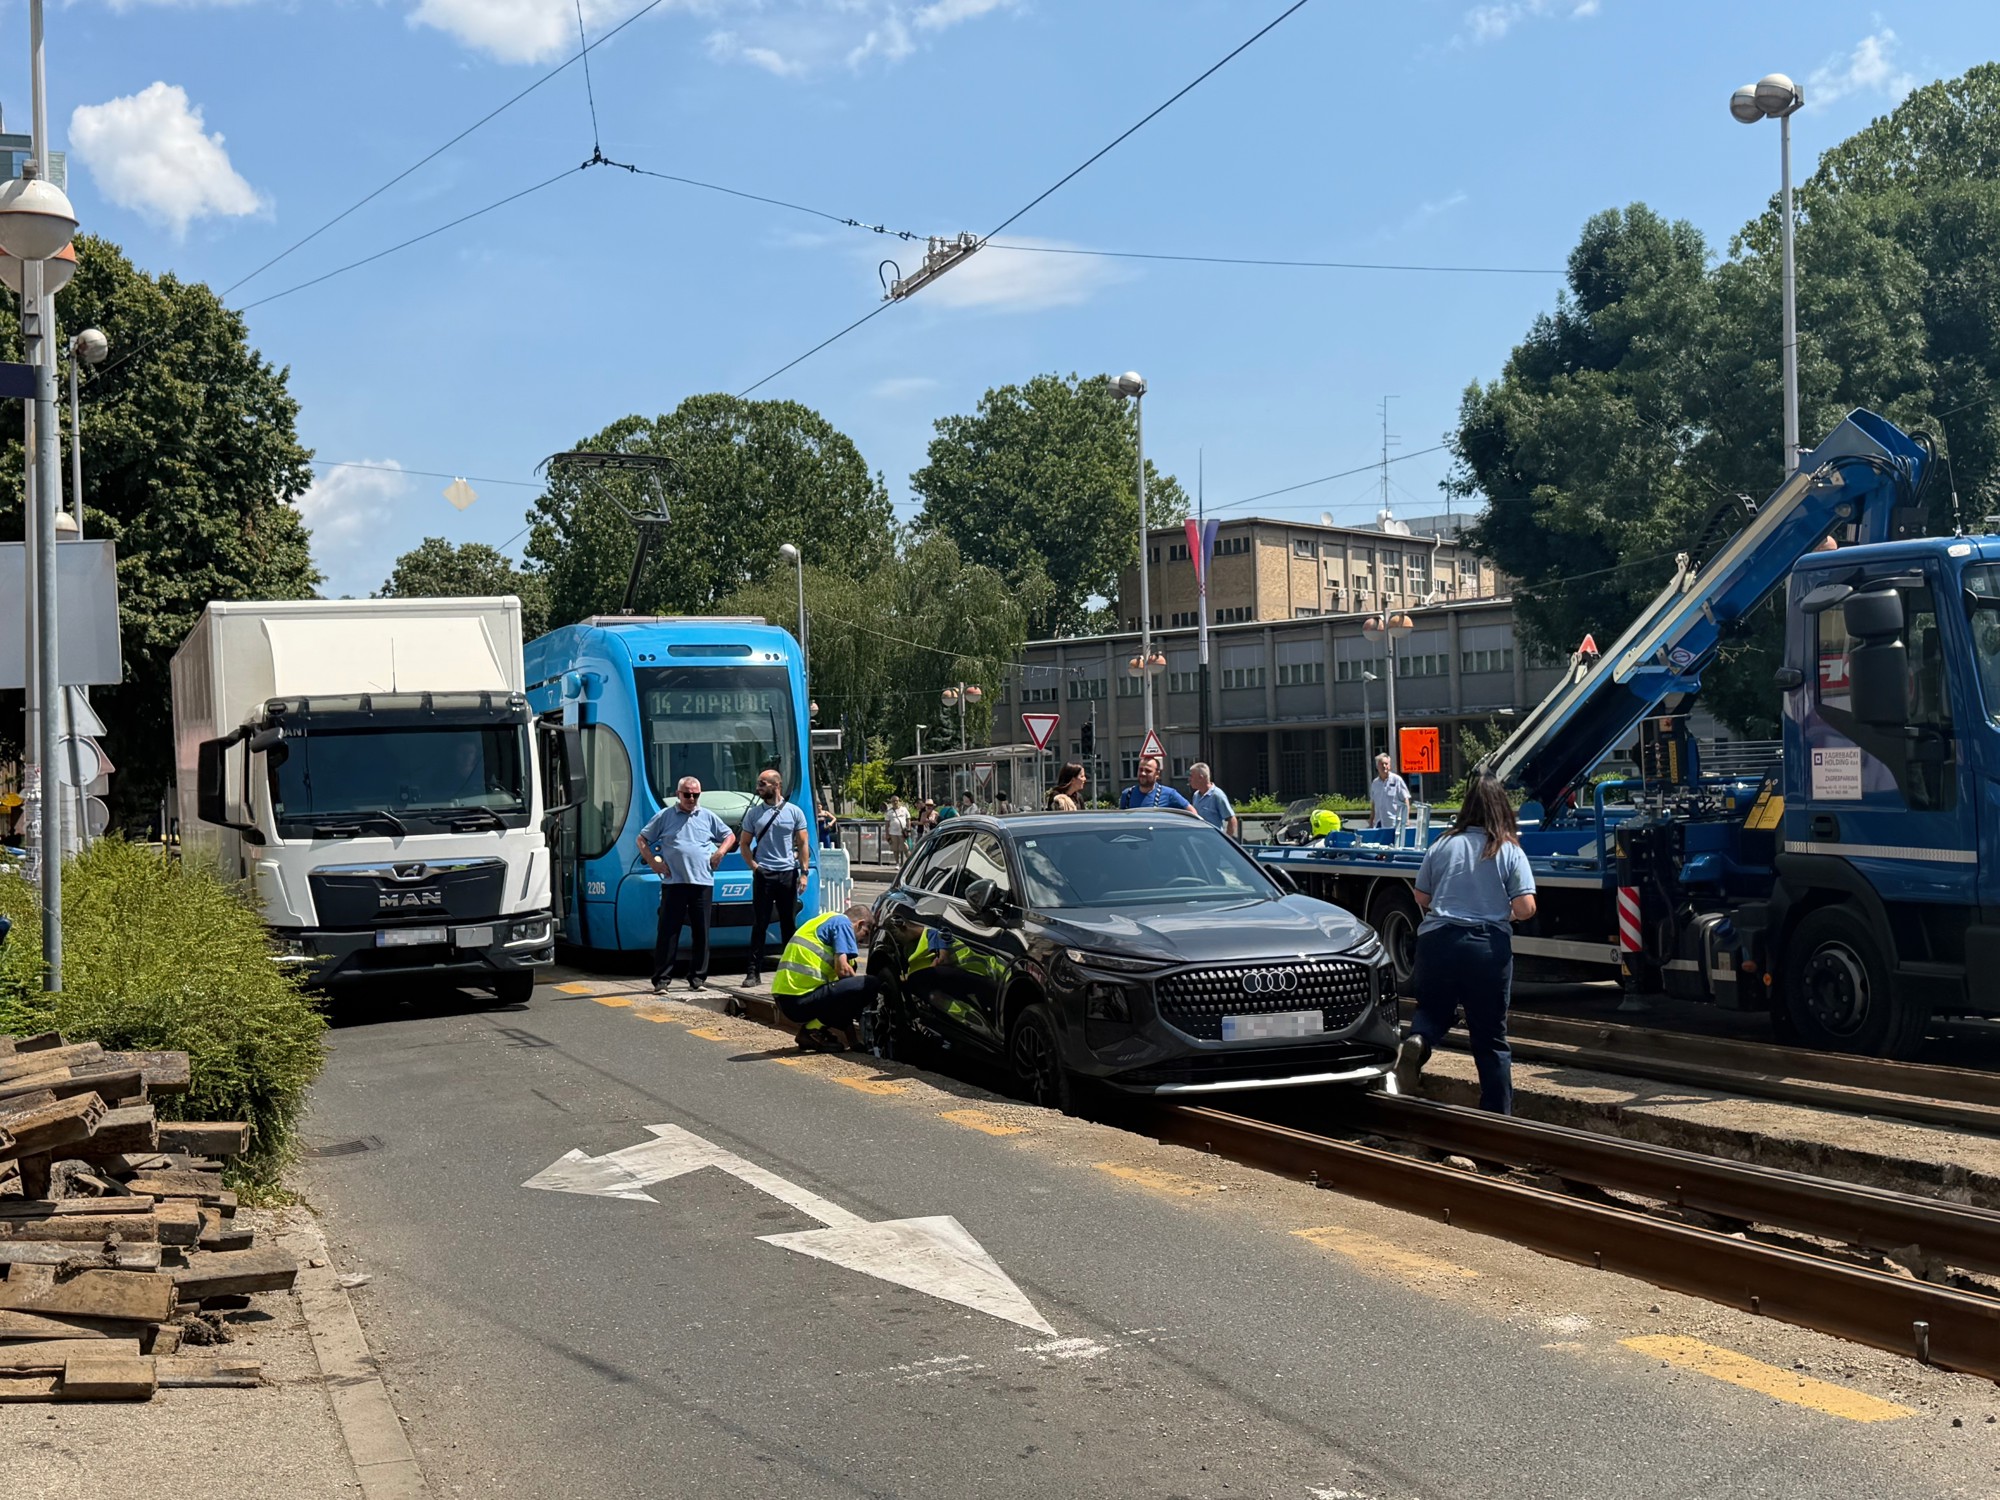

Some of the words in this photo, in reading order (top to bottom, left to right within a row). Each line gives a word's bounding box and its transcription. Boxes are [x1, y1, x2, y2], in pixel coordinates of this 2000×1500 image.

[653, 692, 672, 714] 14
[283, 728, 302, 737] AN
[587, 881, 606, 895] 2205
[721, 883, 750, 897] ZET
[379, 891, 442, 908] MAN
